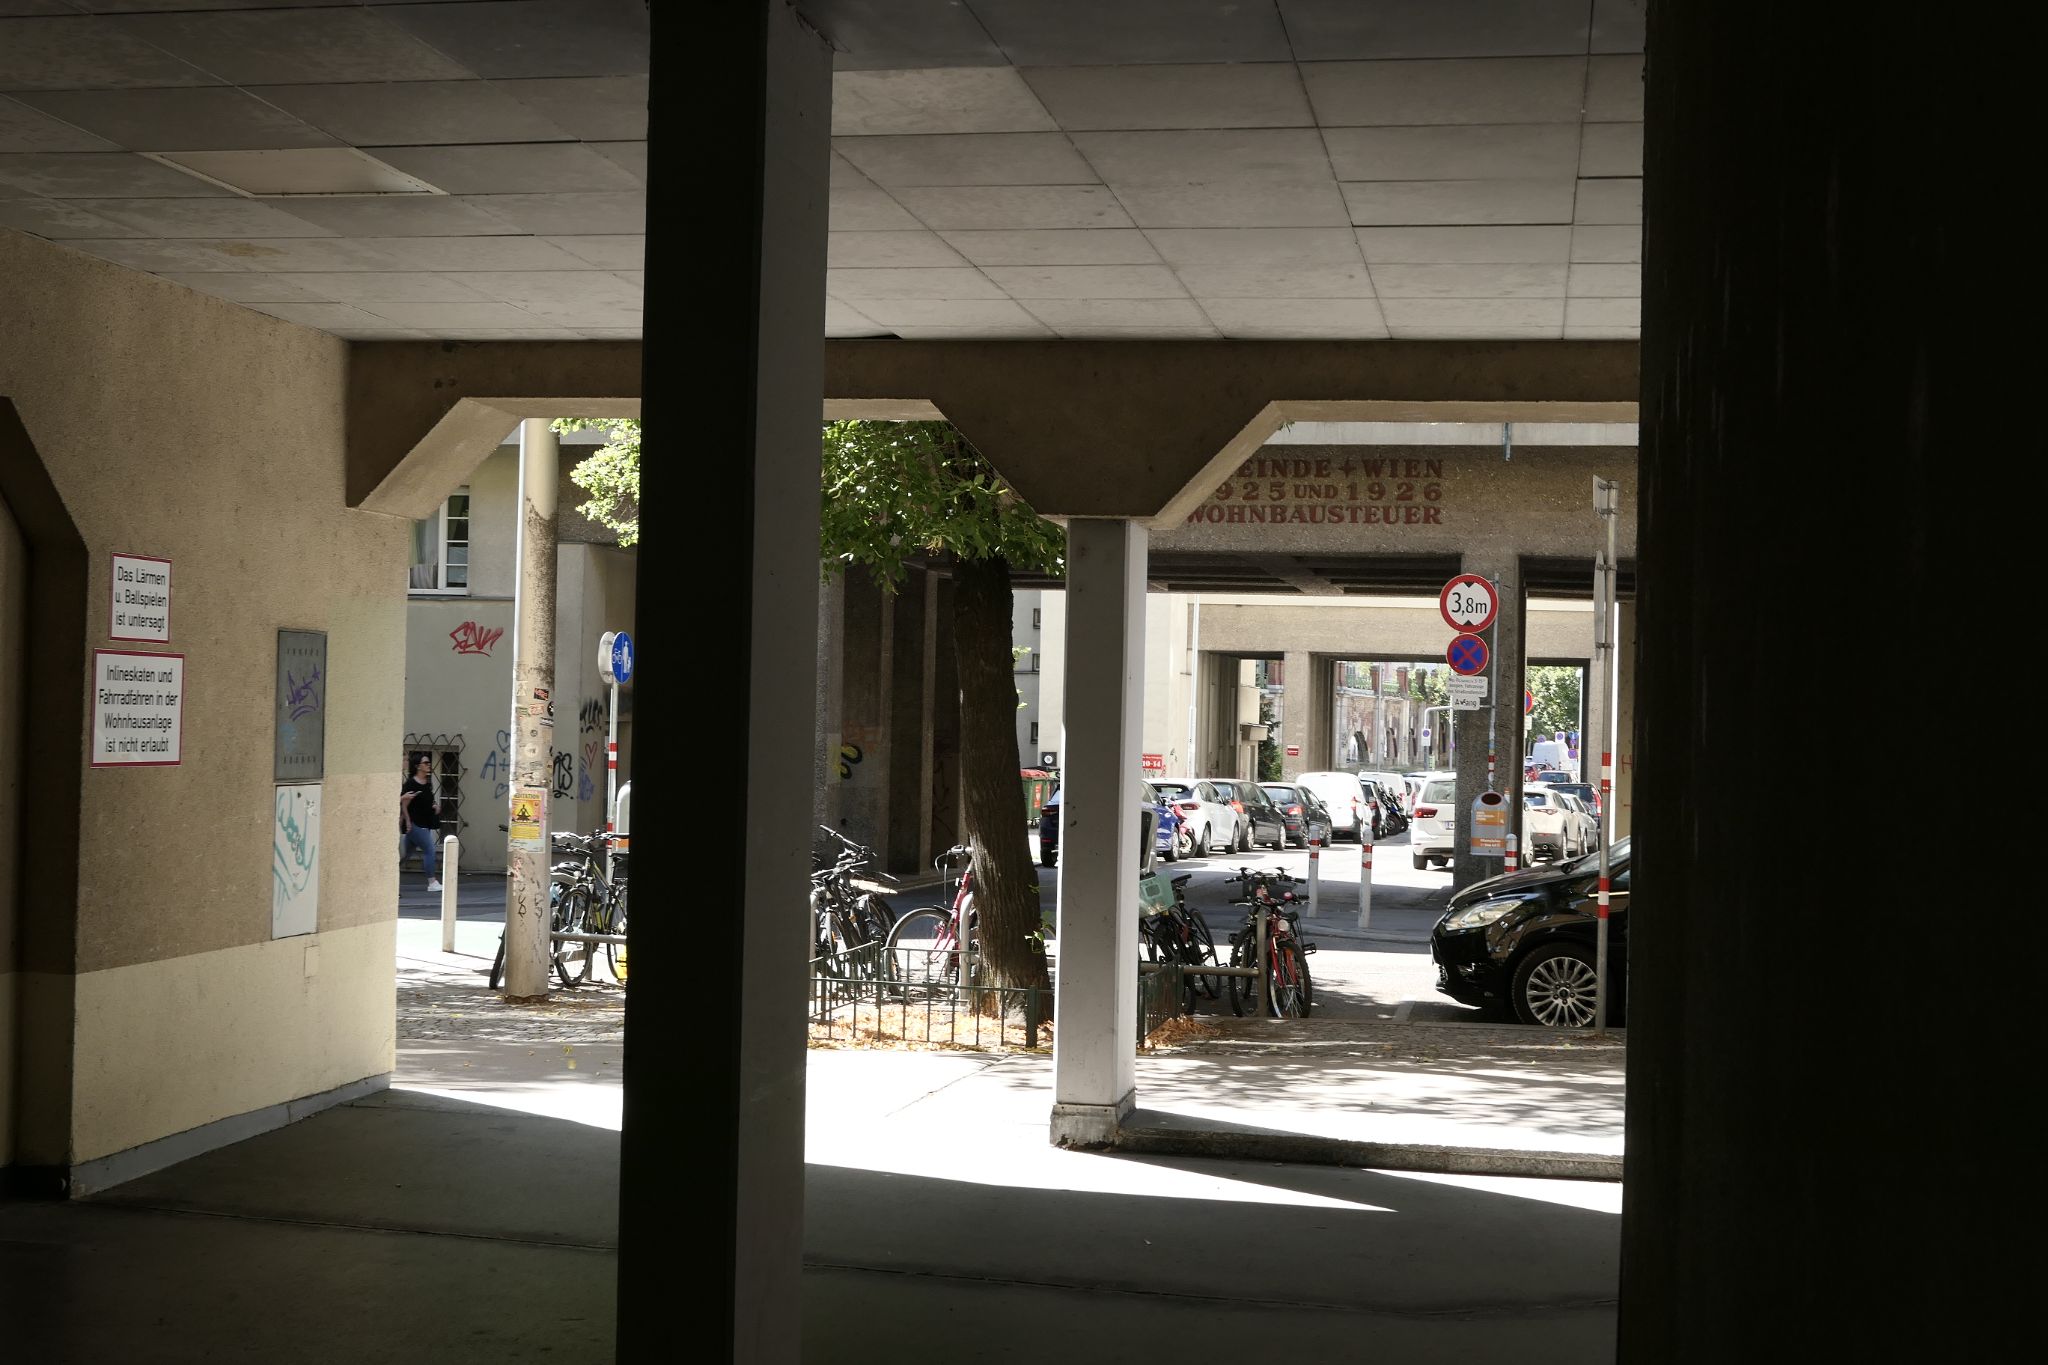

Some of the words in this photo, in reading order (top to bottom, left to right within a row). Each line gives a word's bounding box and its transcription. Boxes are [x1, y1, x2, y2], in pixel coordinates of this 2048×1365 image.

[1231, 458, 1331, 478] EINDE
[1362, 458, 1443, 478] WIEN
[1216, 481, 1287, 501] 925
[1294, 484, 1339, 499] UND
[1347, 481, 1443, 501] 1926
[117, 566, 133, 582] Das
[135, 568, 166, 586] Lärmen
[115, 592, 122, 603] u.
[125, 589, 167, 609] Ballspielen
[1451, 592, 1487, 616] 3,8m
[115, 612, 126, 626] ist
[128, 613, 165, 632] untersagt
[106, 665, 155, 682] Inlineskaten
[158, 668, 173, 683] und
[98, 688, 154, 706] Fahrradfahren
[156, 691, 163, 706] in
[165, 691, 178, 706] der
[104, 713, 172, 733] Wohnhausanlage
[105, 738, 116, 753] ist
[118, 737, 138, 752] nicht
[140, 737, 169, 753] erlaubt
